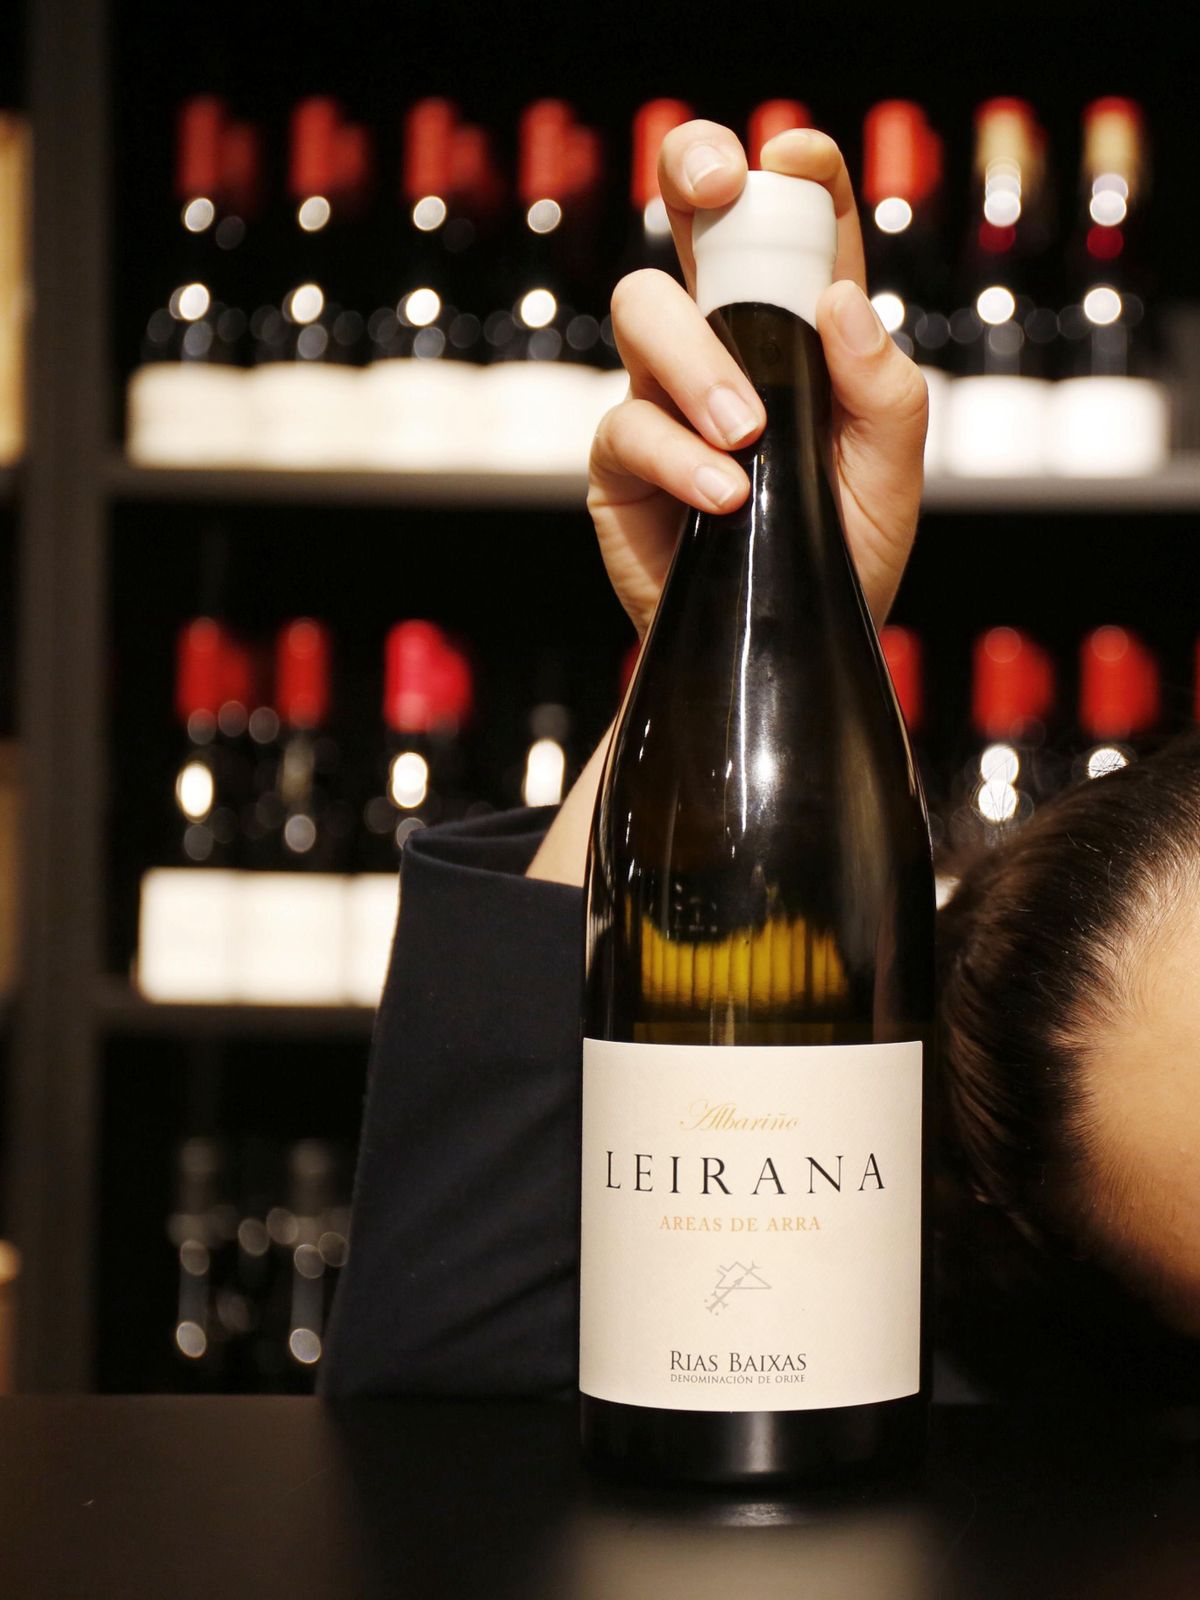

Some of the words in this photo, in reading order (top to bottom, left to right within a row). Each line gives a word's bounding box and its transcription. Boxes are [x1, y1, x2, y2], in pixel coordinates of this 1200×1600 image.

[679, 1100, 800, 1132] Albariño
[605, 1151, 886, 1195] LEIRANA
[660, 1215, 722, 1232] AREAS
[731, 1217, 758, 1232] DE
[766, 1215, 821, 1232] ARRA
[729, 1352, 807, 1372] BAIXAS
[670, 1373, 753, 1385] DENOMINACIÓN
[758, 1375, 771, 1385] DE
[775, 1374, 806, 1384] ORIXE
